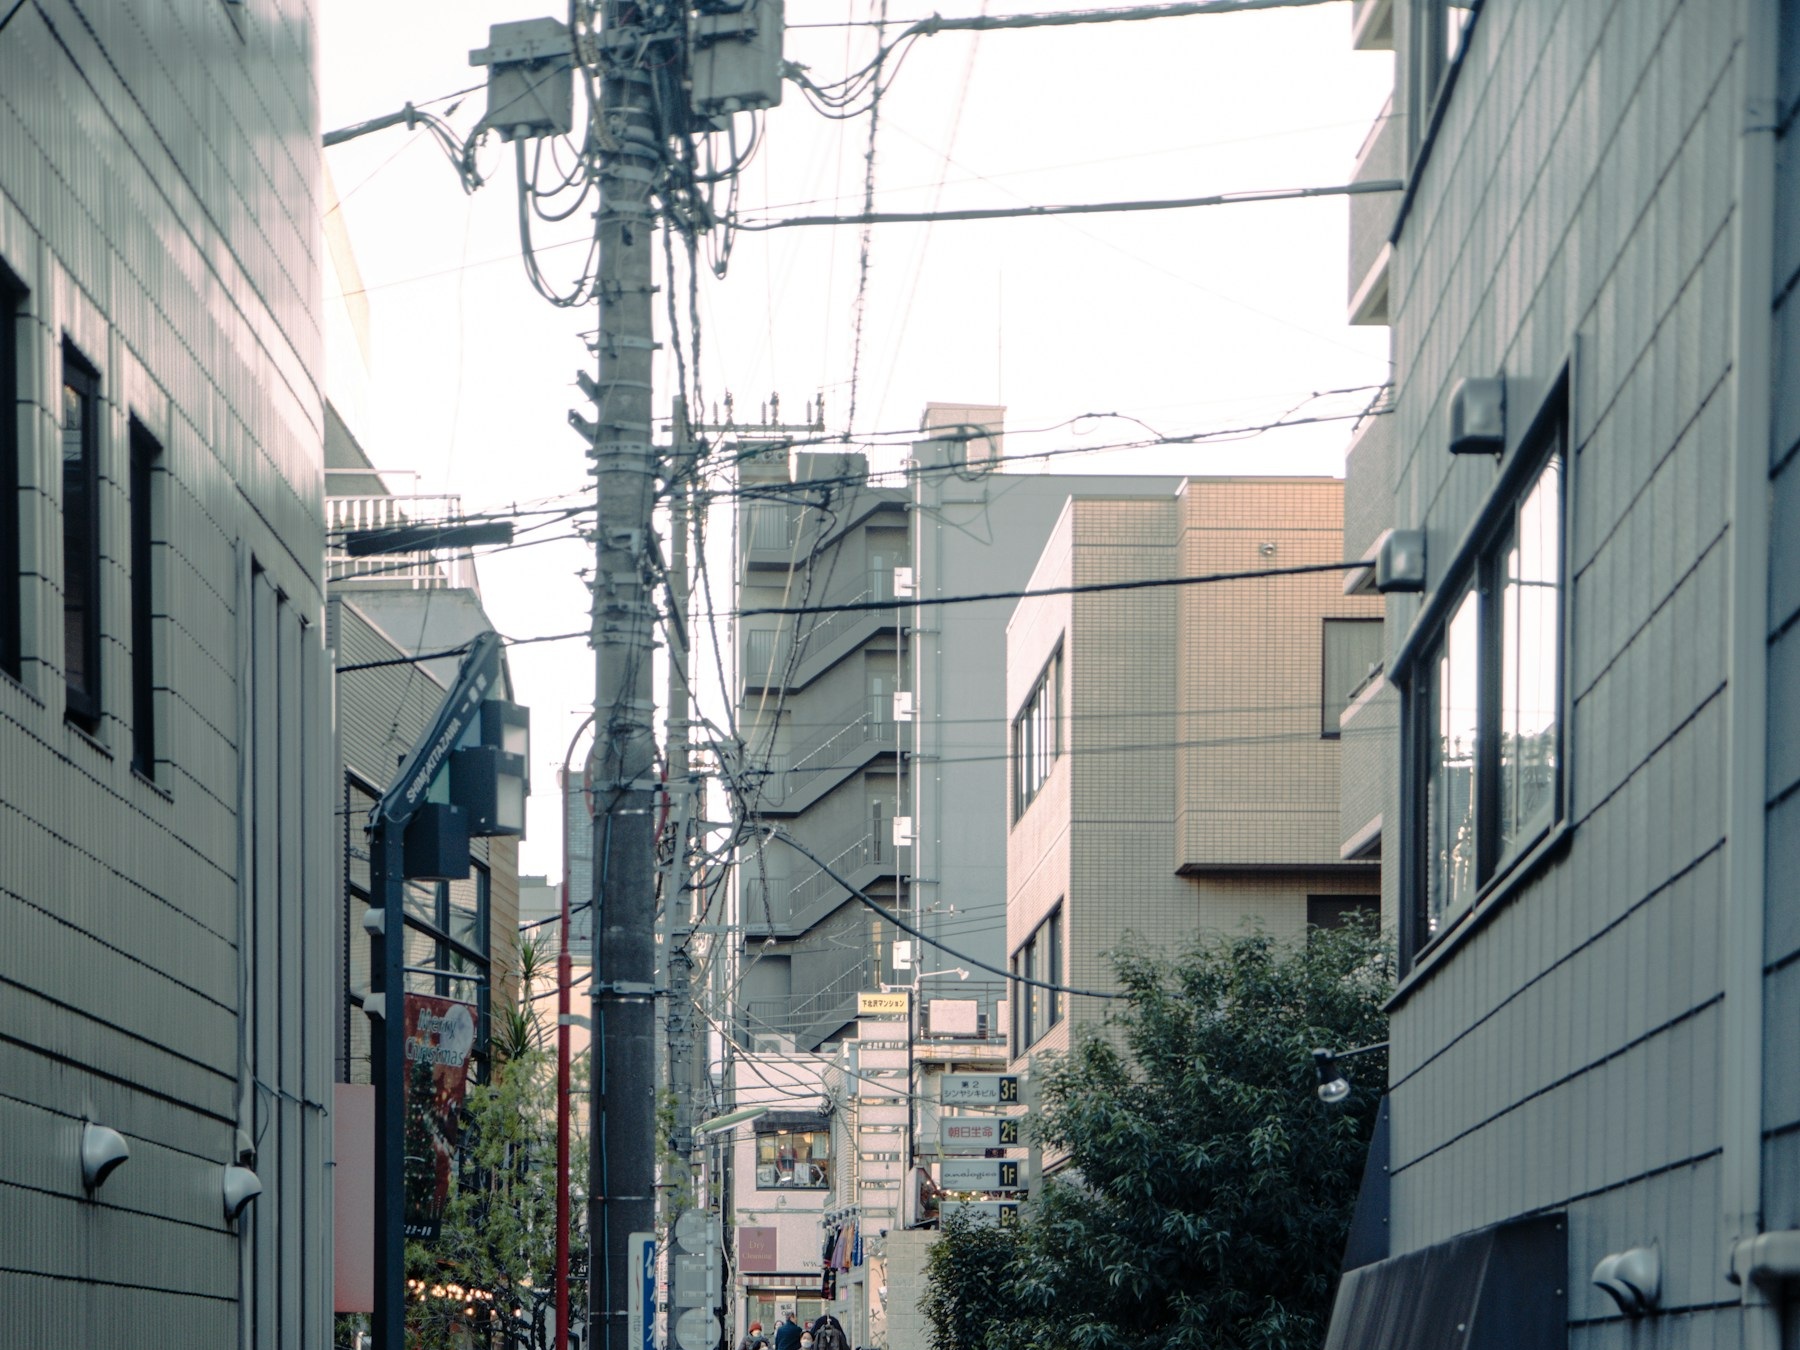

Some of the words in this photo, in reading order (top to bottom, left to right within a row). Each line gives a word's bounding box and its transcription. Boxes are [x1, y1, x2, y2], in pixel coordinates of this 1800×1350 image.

[417, 1008, 457, 1040] Merry
[405, 1036, 464, 1068] Christmas
[1001, 1079, 1016, 1100] 3F
[948, 1126, 993, 1138] 朝日生命
[1001, 1121, 1016, 1142] 2F
[1002, 1164, 1015, 1184] 1F
[749, 1240, 765, 1250] Dry
